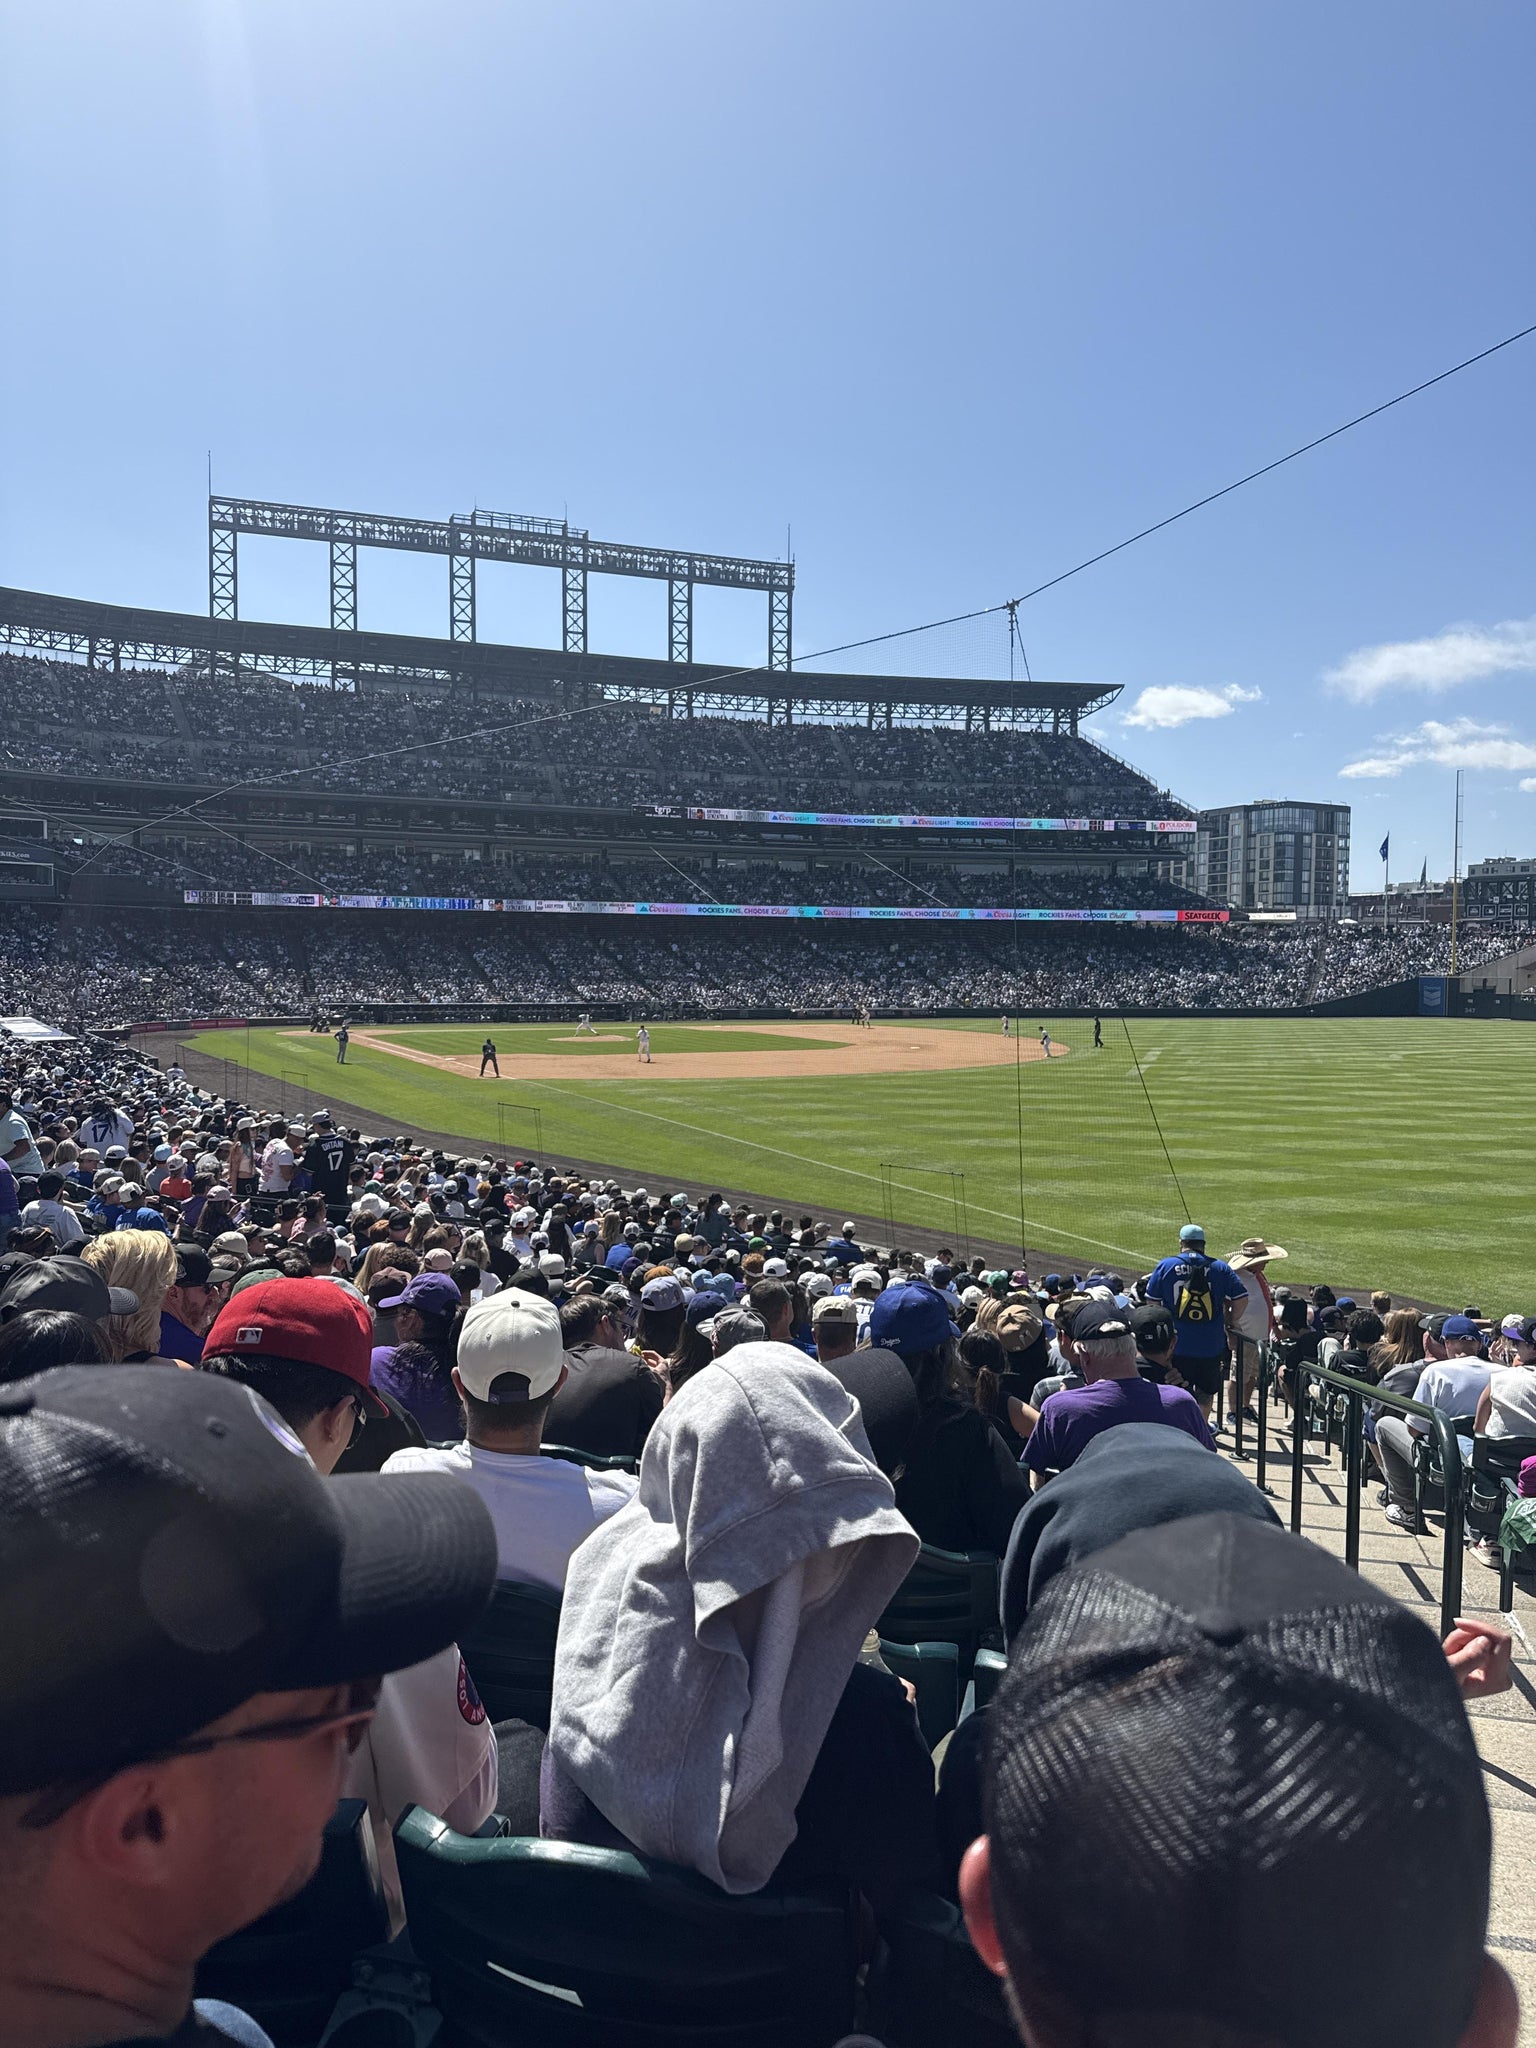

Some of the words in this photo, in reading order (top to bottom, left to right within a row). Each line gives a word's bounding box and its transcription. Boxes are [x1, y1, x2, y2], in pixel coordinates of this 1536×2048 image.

[1184, 911, 1221, 920] SEATGEEK
[92, 1123, 110, 1143] 17
[321, 1140, 344, 1151] OHTANI
[328, 1150, 344, 1171] 17
[1174, 1264, 1210, 1277] SCUY
[880, 1337, 901, 1347] Dodgers
